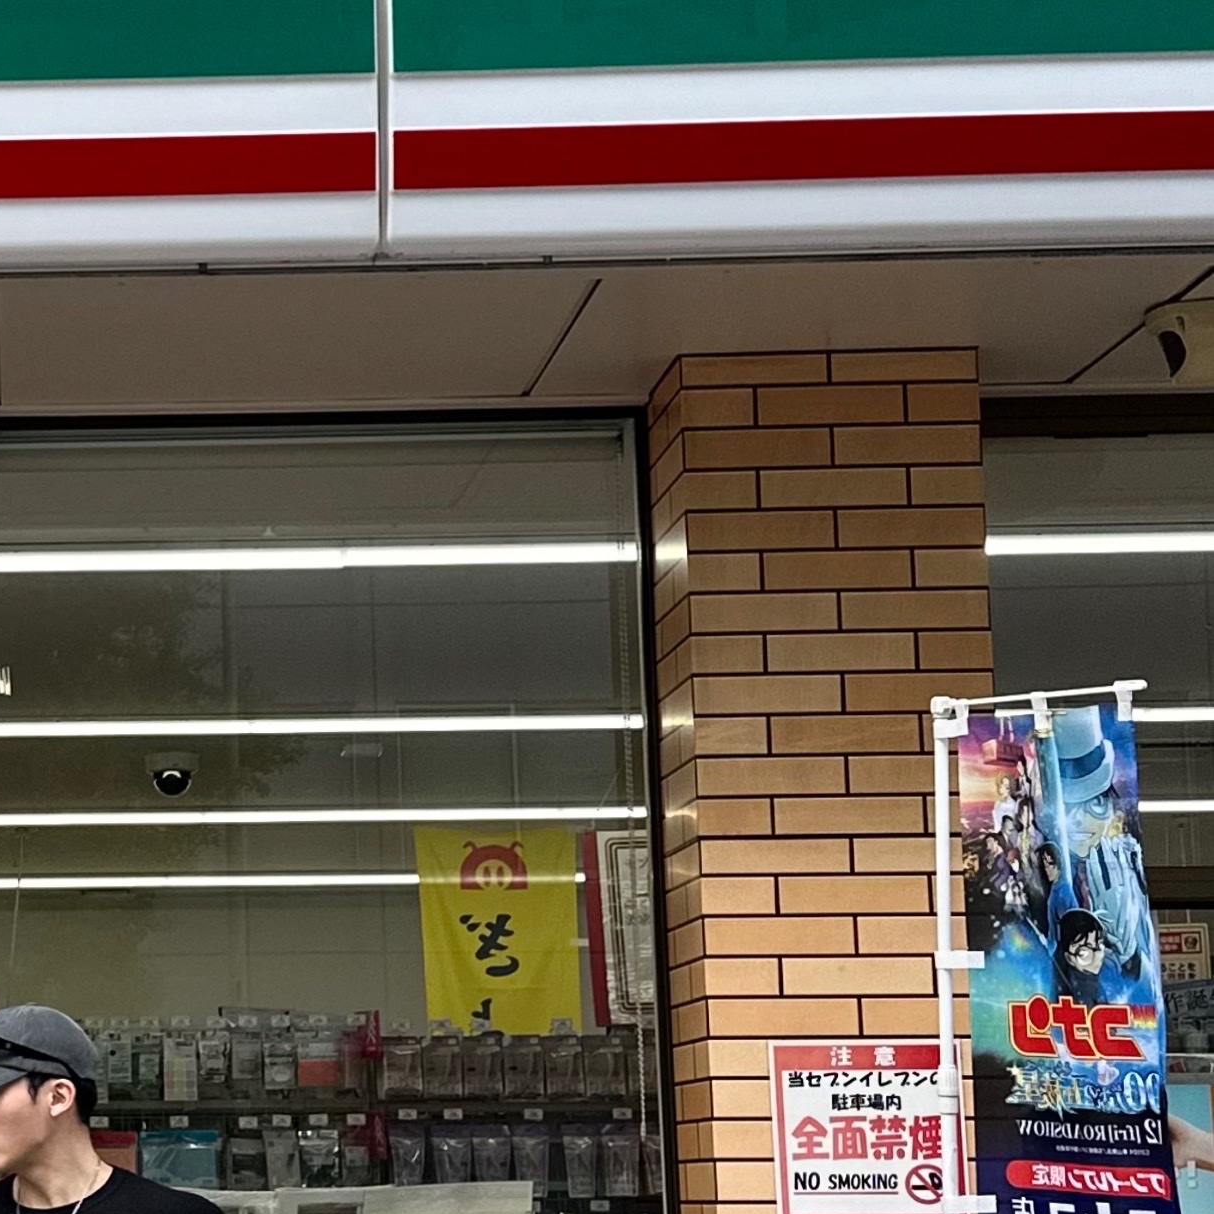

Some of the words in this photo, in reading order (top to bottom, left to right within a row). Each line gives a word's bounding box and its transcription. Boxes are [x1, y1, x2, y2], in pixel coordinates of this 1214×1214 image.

[831, 1094, 902, 1111] 駐車場内
[791, 1115, 942, 1161] 全面禁煙
[793, 1172, 820, 1191] NO
[828, 1173, 899, 1190] SMOKING
